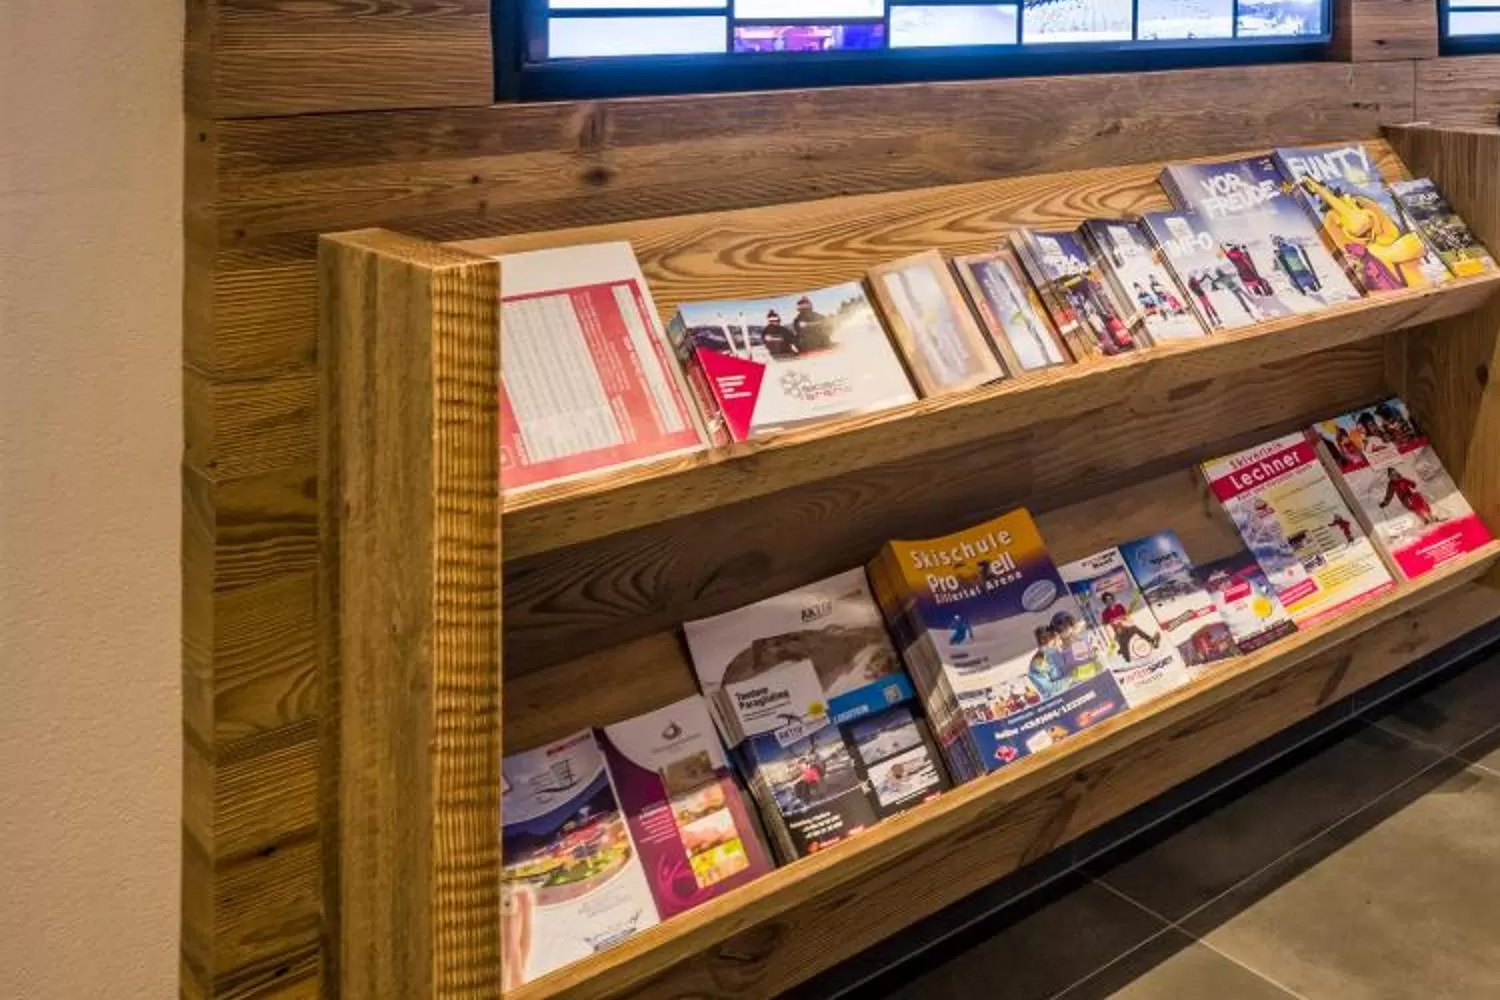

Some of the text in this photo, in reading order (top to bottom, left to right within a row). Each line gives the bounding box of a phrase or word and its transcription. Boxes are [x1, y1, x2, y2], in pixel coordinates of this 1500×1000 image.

[1200, 172, 1243, 200] VOR
[1201, 180, 1280, 219] FREUDE
[1229, 451, 1301, 490] Lechner
[910, 530, 1012, 569] Skischule
[927, 573, 960, 594] Pro
